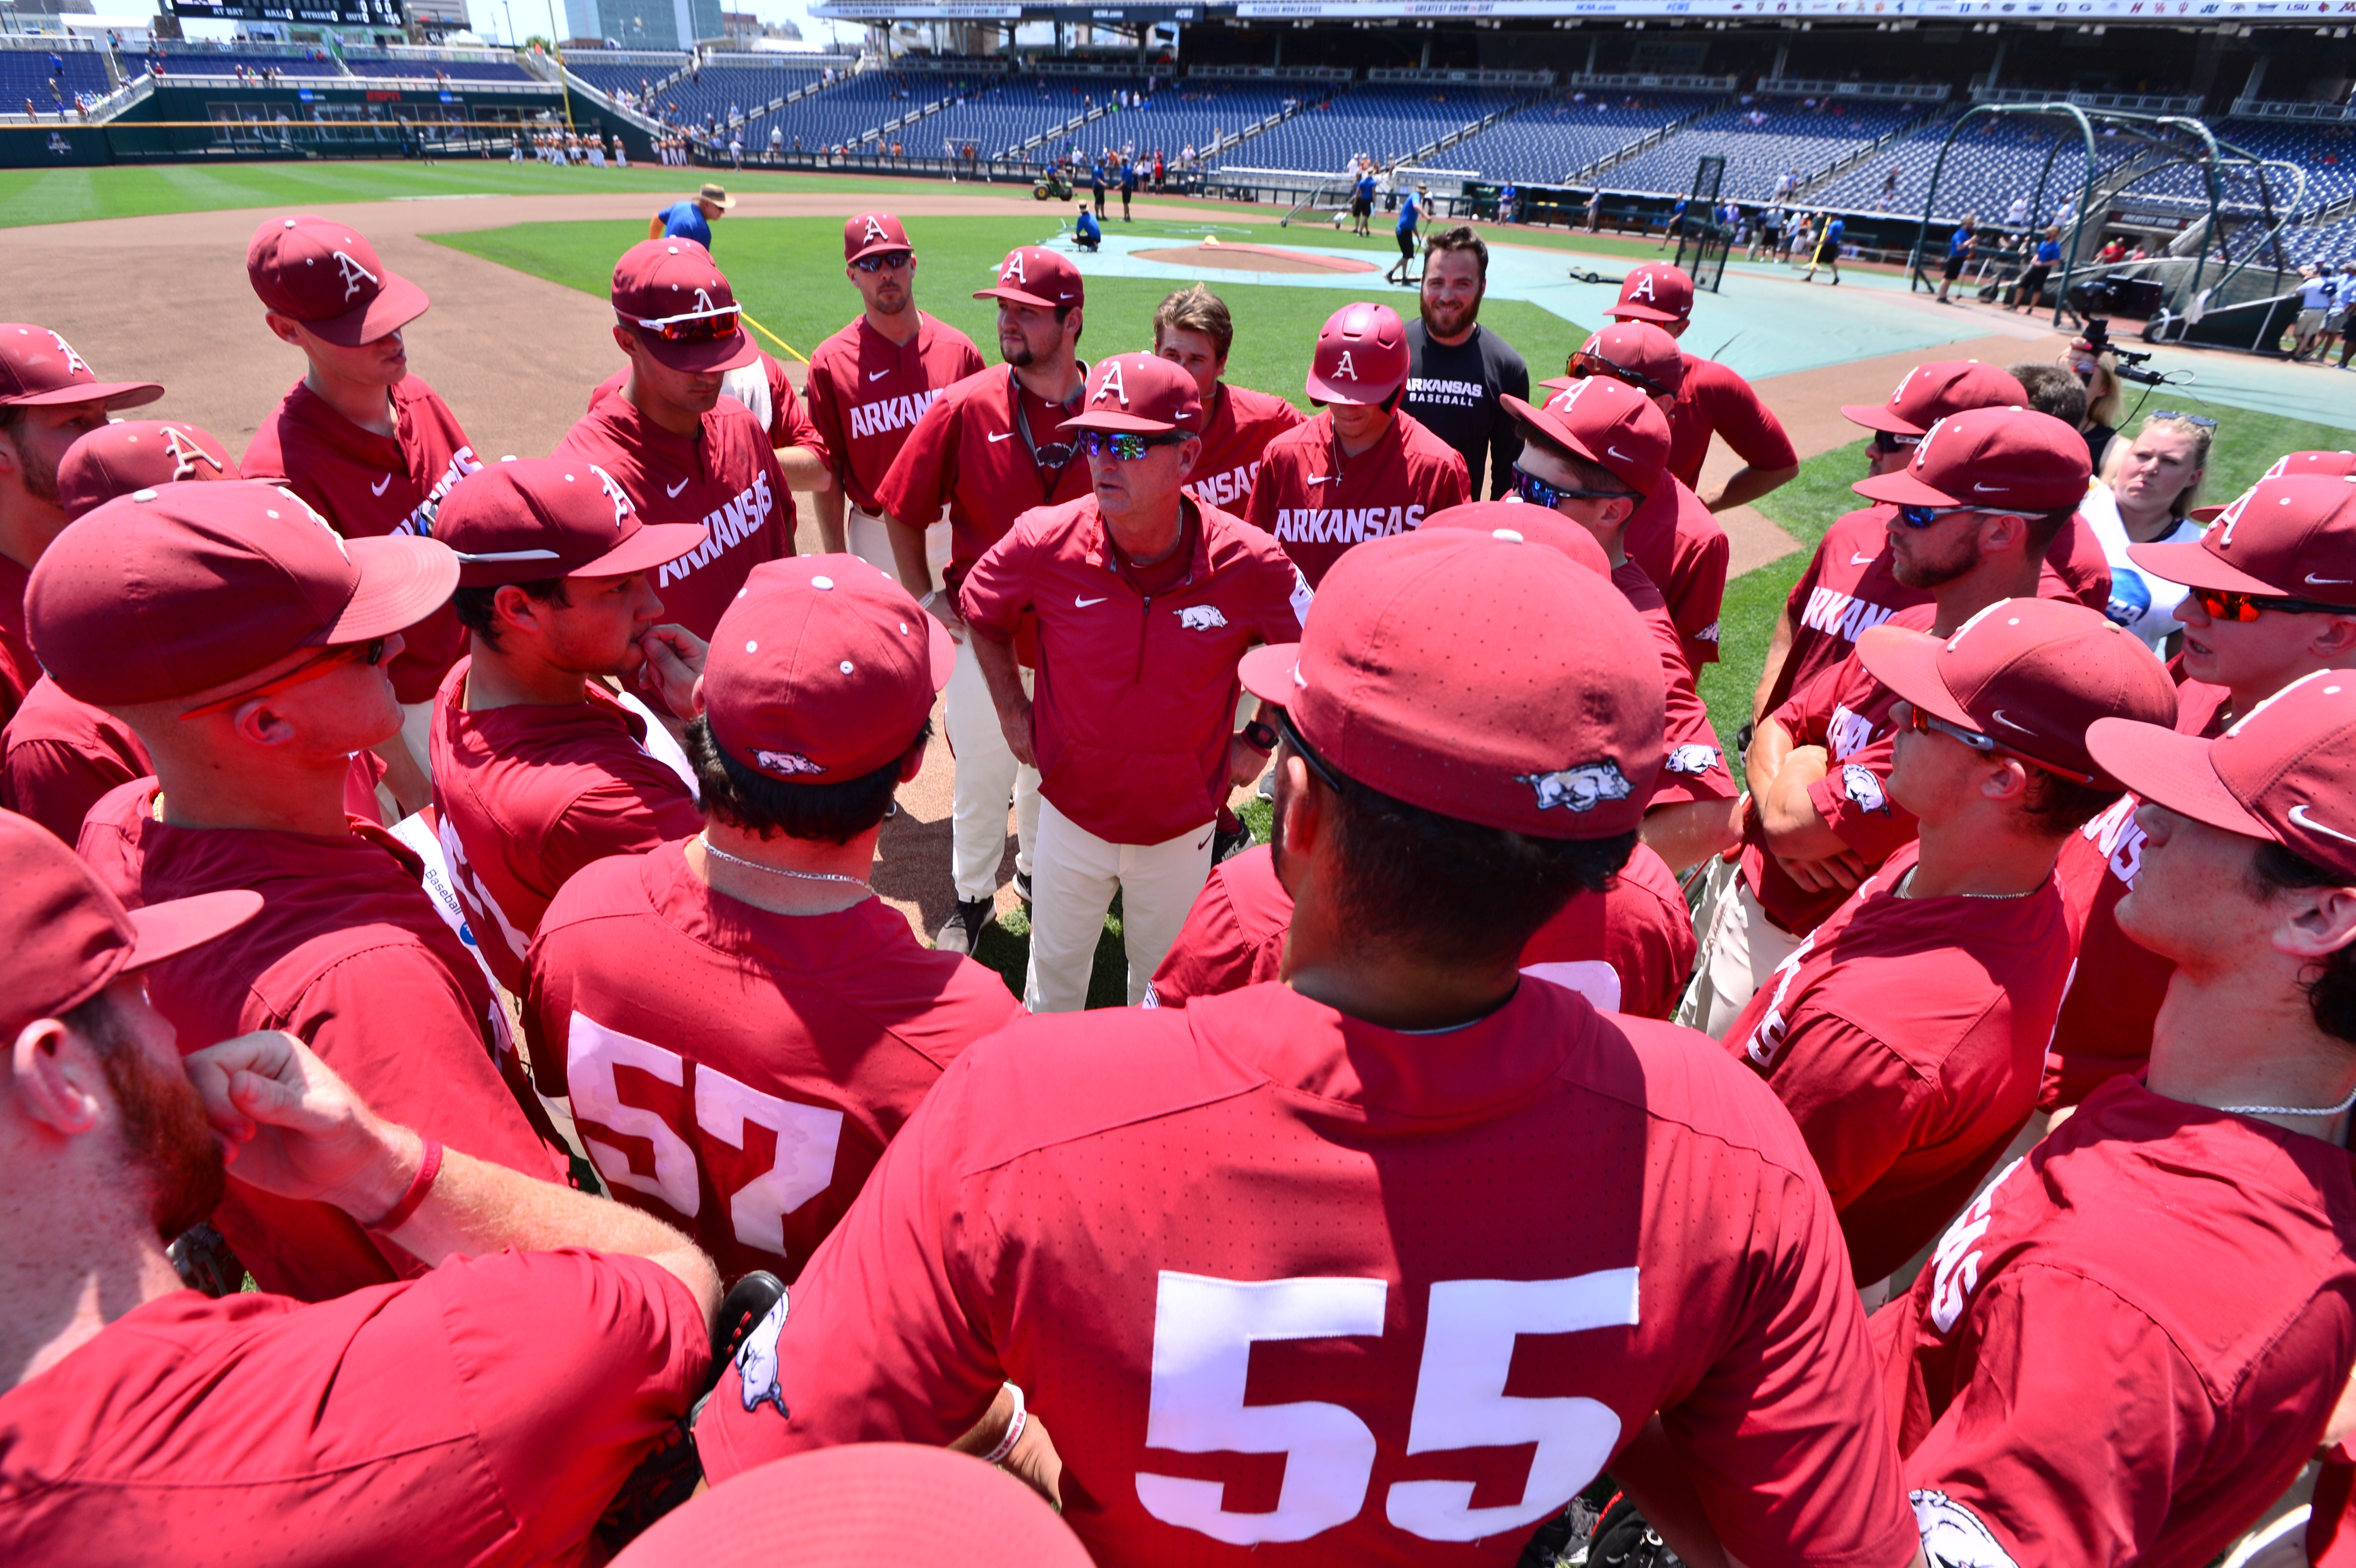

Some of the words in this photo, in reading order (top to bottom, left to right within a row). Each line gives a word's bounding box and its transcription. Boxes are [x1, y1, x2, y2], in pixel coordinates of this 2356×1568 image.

[264, 9, 286, 18] BALL
[300, 11, 332, 21] STRIKE
[346, 12, 363, 22] OUT
[1092, 10, 1123, 18] NCAA.com
[1175, 9, 1194, 19] #CWS
[1666, 3, 1690, 11] #CWS
[863, 216, 889, 246] A
[333, 251, 377, 303] A
[1000, 251, 1026, 284] A
[1628, 272, 1656, 302] A
[49, 329, 94, 376] A
[1331, 350, 1358, 382] A
[1090, 360, 1129, 405] A
[1409, 392, 1473, 407] BASEBALL
[1549, 375, 1593, 414] A
[158, 425, 223, 481] A
[1912, 417, 1947, 467] A
[589, 464, 636, 527] A
[1274, 504, 1425, 545] ARKANSAS
[2207, 486, 2258, 546] A
[1221, 839, 1242, 862] NIKE
[425, 869, 462, 916] Baseball
[567, 1010, 844, 1258] 57
[1135, 1266, 1640, 1546] 55
